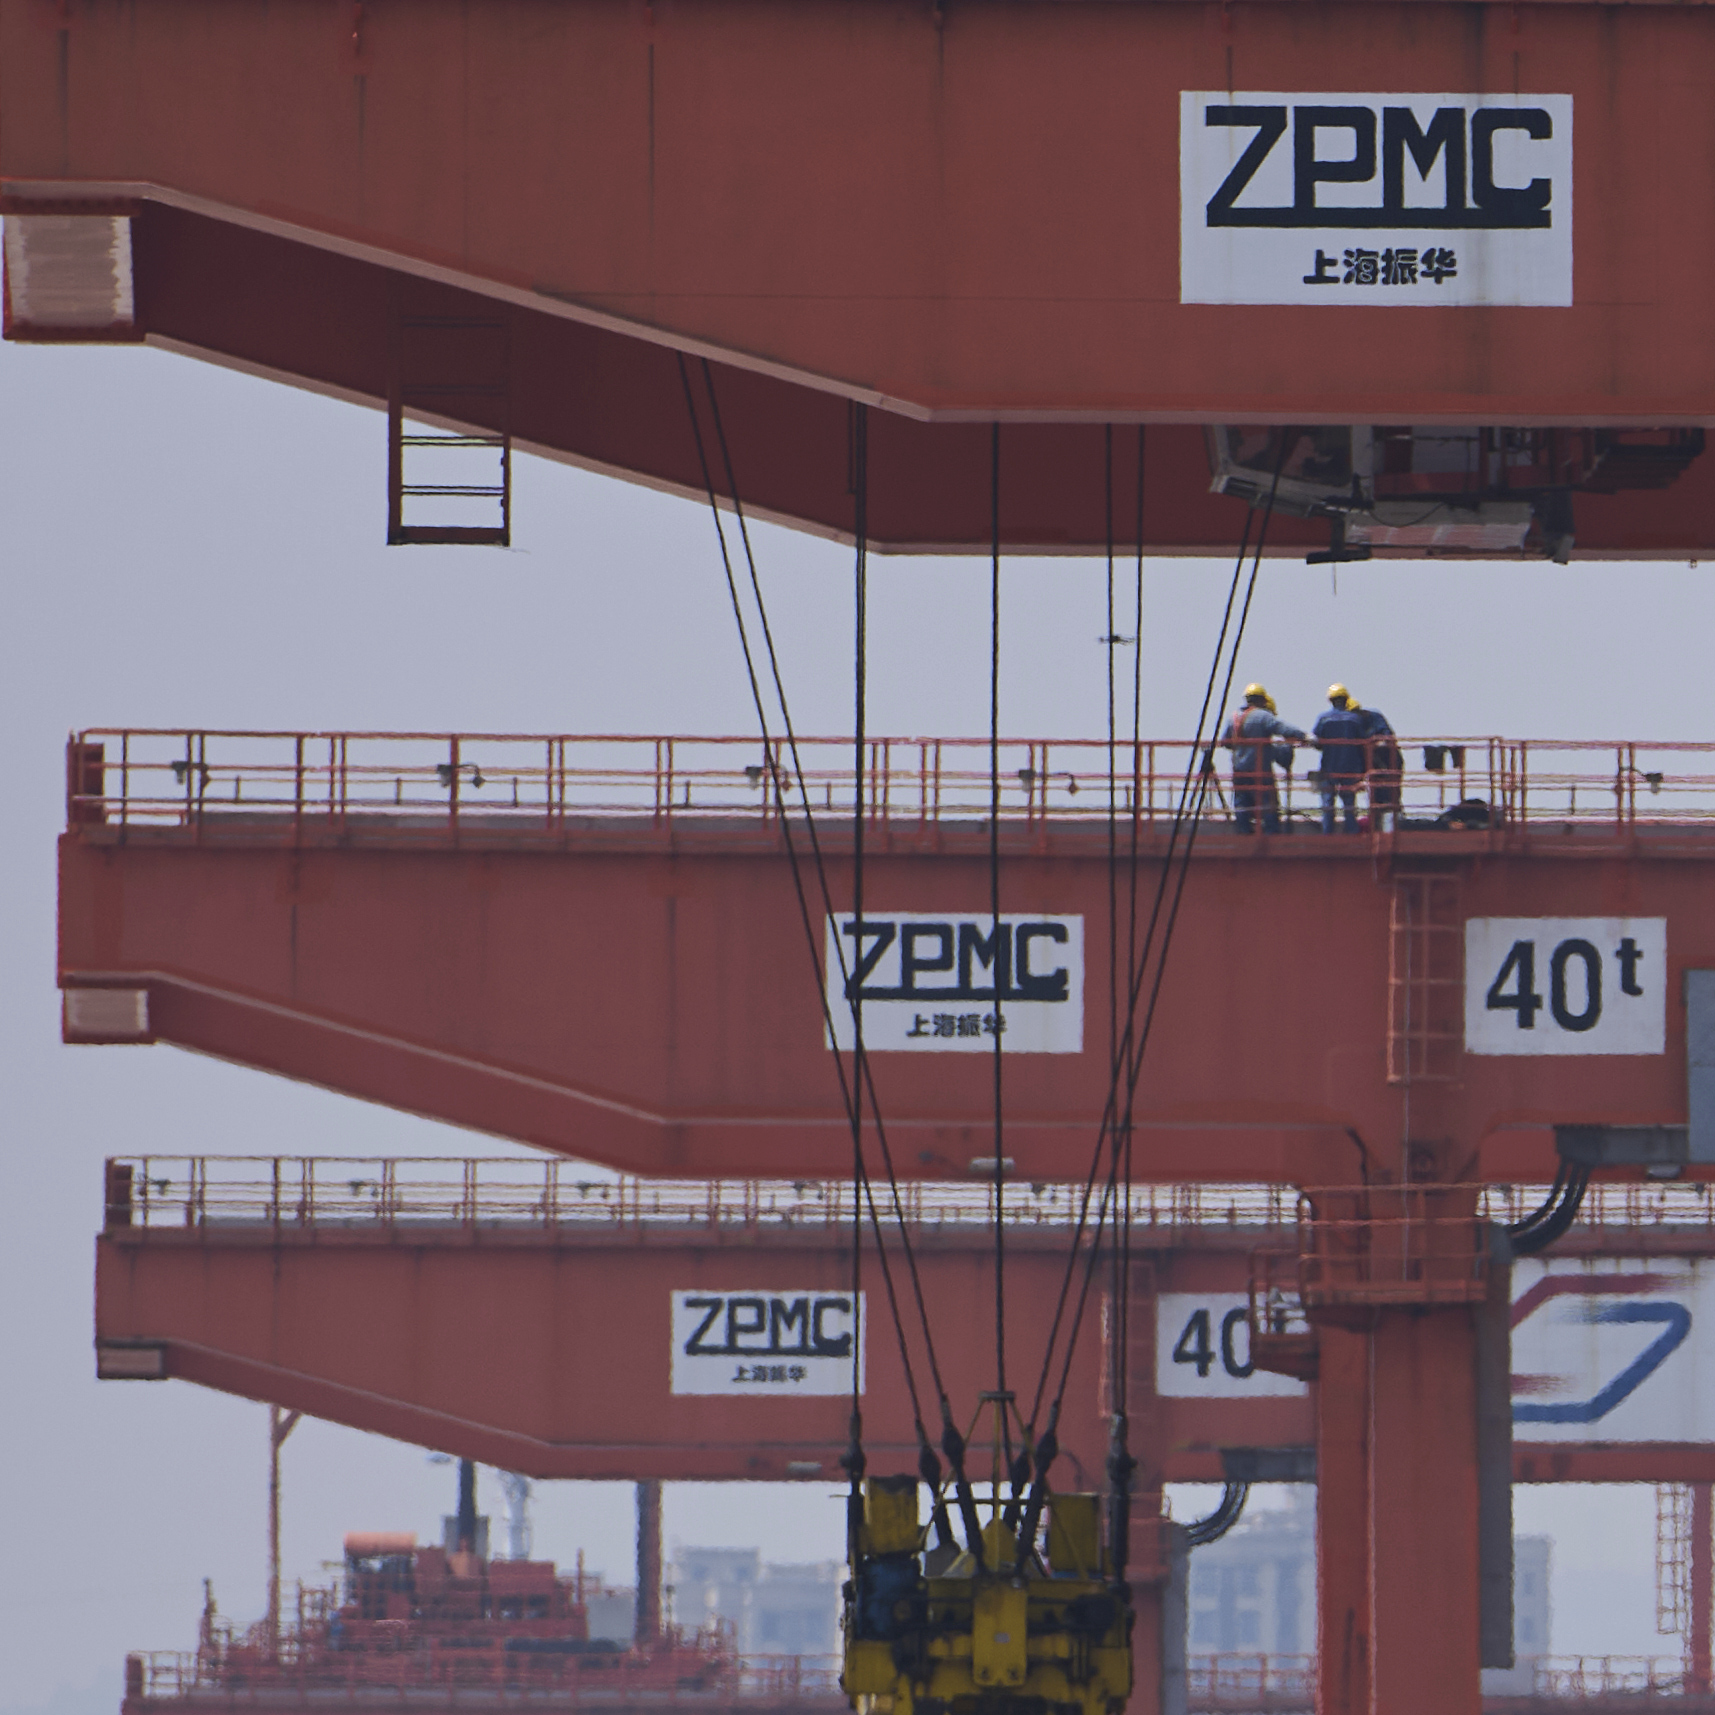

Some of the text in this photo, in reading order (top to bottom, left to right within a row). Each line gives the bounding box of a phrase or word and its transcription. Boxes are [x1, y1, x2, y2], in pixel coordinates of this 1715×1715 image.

[1205, 105, 1553, 229] ZPMC
[1302, 248, 1458, 285] 上海振华
[842, 921, 1070, 1002] ZPMC
[906, 1013, 1008, 1038] 上海振华
[683, 1298, 852, 1357] ZPMC
